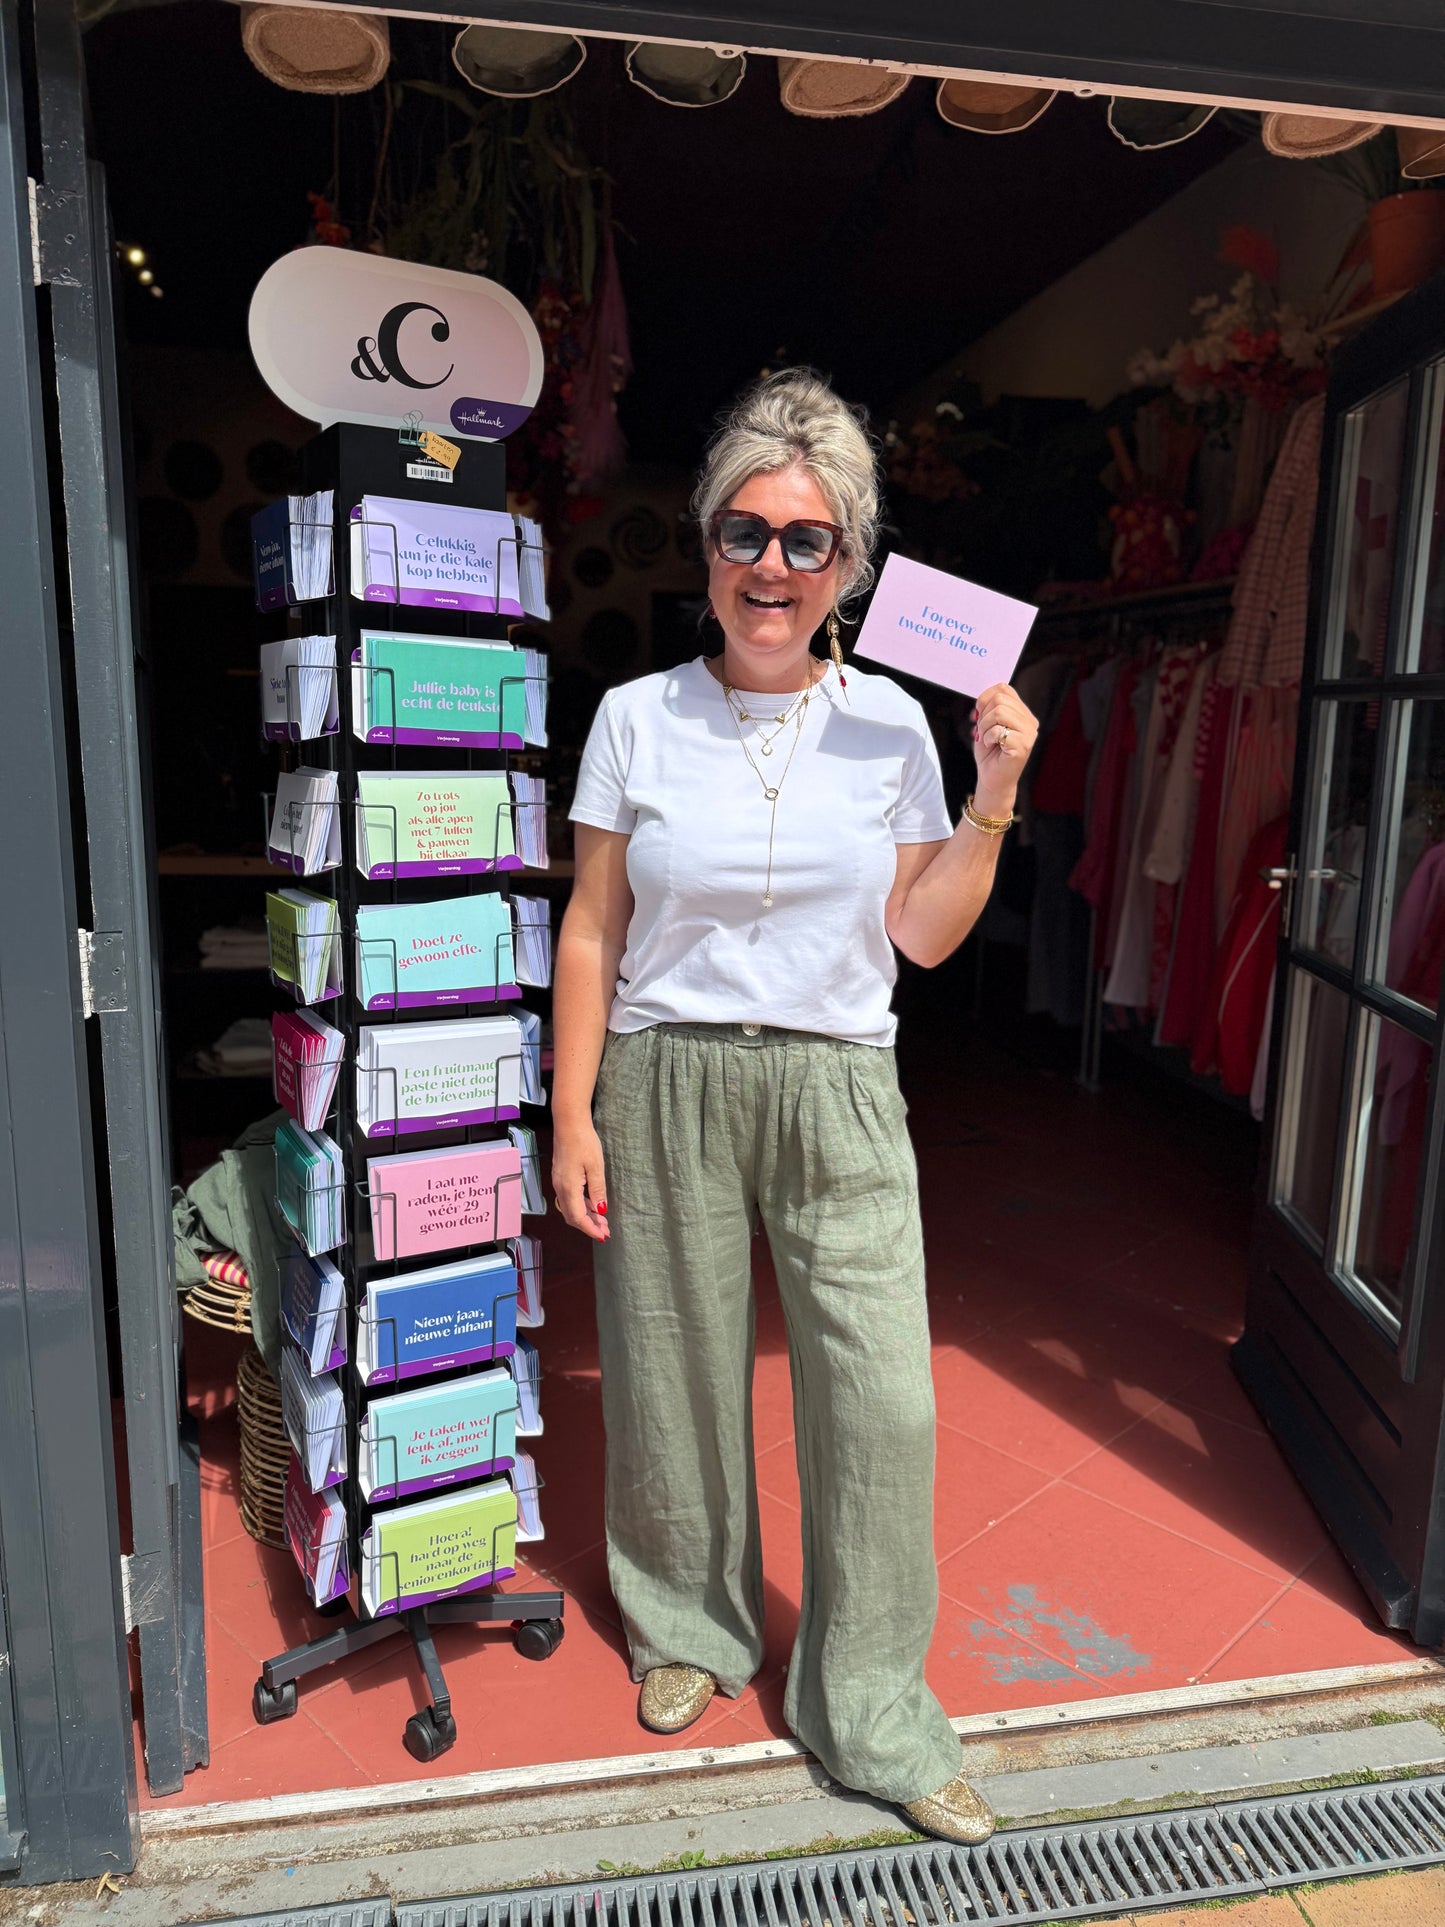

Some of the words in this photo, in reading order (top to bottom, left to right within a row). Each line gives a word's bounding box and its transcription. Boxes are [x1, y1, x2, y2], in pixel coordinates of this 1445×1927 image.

[457, 411, 504, 428] Hallmark
[415, 533, 477, 554] Gelukkig
[424, 550, 437, 564] je
[441, 553, 461, 566] die
[465, 555, 493, 569] kale
[406, 564, 432, 580] kop
[436, 567, 488, 583] hebben
[921, 605, 977, 635] Forever
[898, 615, 988, 658] twenty-three
[409, 680, 446, 695] Jullie
[450, 683, 481, 699] baby
[484, 685, 496, 698] is
[401, 697, 433, 709] echt
[436, 698, 454, 710] de
[416, 792, 431, 801] Zo
[433, 791, 460, 801] trots
[423, 805, 437, 814] op
[439, 803, 456, 814] jou
[408, 816, 423, 825] als
[425, 815, 444, 825] alle
[447, 815, 474, 825] apen
[411, 828, 432, 837] met
[434, 826, 441, 836] 7
[443, 825, 473, 836] lullen
[416, 839, 426, 849] &
[428, 838, 470, 850] pauwen
[419, 850, 433, 860] bij
[436, 849, 468, 859] elkaar
[412, 936, 445, 950] Doet
[449, 933, 463, 944] ze
[398, 950, 450, 969] gewoon
[452, 944, 482, 957] effe.
[404, 1067, 430, 1079] Een
[401, 1080, 438, 1095] paste
[441, 1076, 466, 1088] niet
[470, 1074, 497, 1085] doo
[405, 1095, 422, 1106] de
[426, 1087, 497, 1104] brievenbus
[428, 1177, 456, 1190] Laat
[459, 1175, 479, 1185] me
[454, 1189, 465, 1202] je
[428, 1203, 460, 1217] wéér
[463, 1200, 479, 1212] 29
[419, 1211, 490, 1236] geworden?
[414, 1313, 454, 1329] Nieuw
[456, 1309, 485, 1324] jaar,
[405, 1328, 451, 1345] nieuwe
[453, 1320, 493, 1335] inham
[410, 1431, 426, 1442] Je
[429, 1421, 465, 1438] takelt
[469, 1415, 491, 1428] wel
[407, 1441, 435, 1455] leuk
[456, 1428, 488, 1444] moet
[420, 1454, 432, 1465] ik
[435, 1444, 479, 1462] zeggen
[429, 1526, 472, 1546] Hoera!
[410, 1547, 440, 1563] hard
[443, 1544, 459, 1555] op
[463, 1537, 487, 1549] weg
[426, 1557, 454, 1571] naar
[457, 1552, 473, 1563] de
